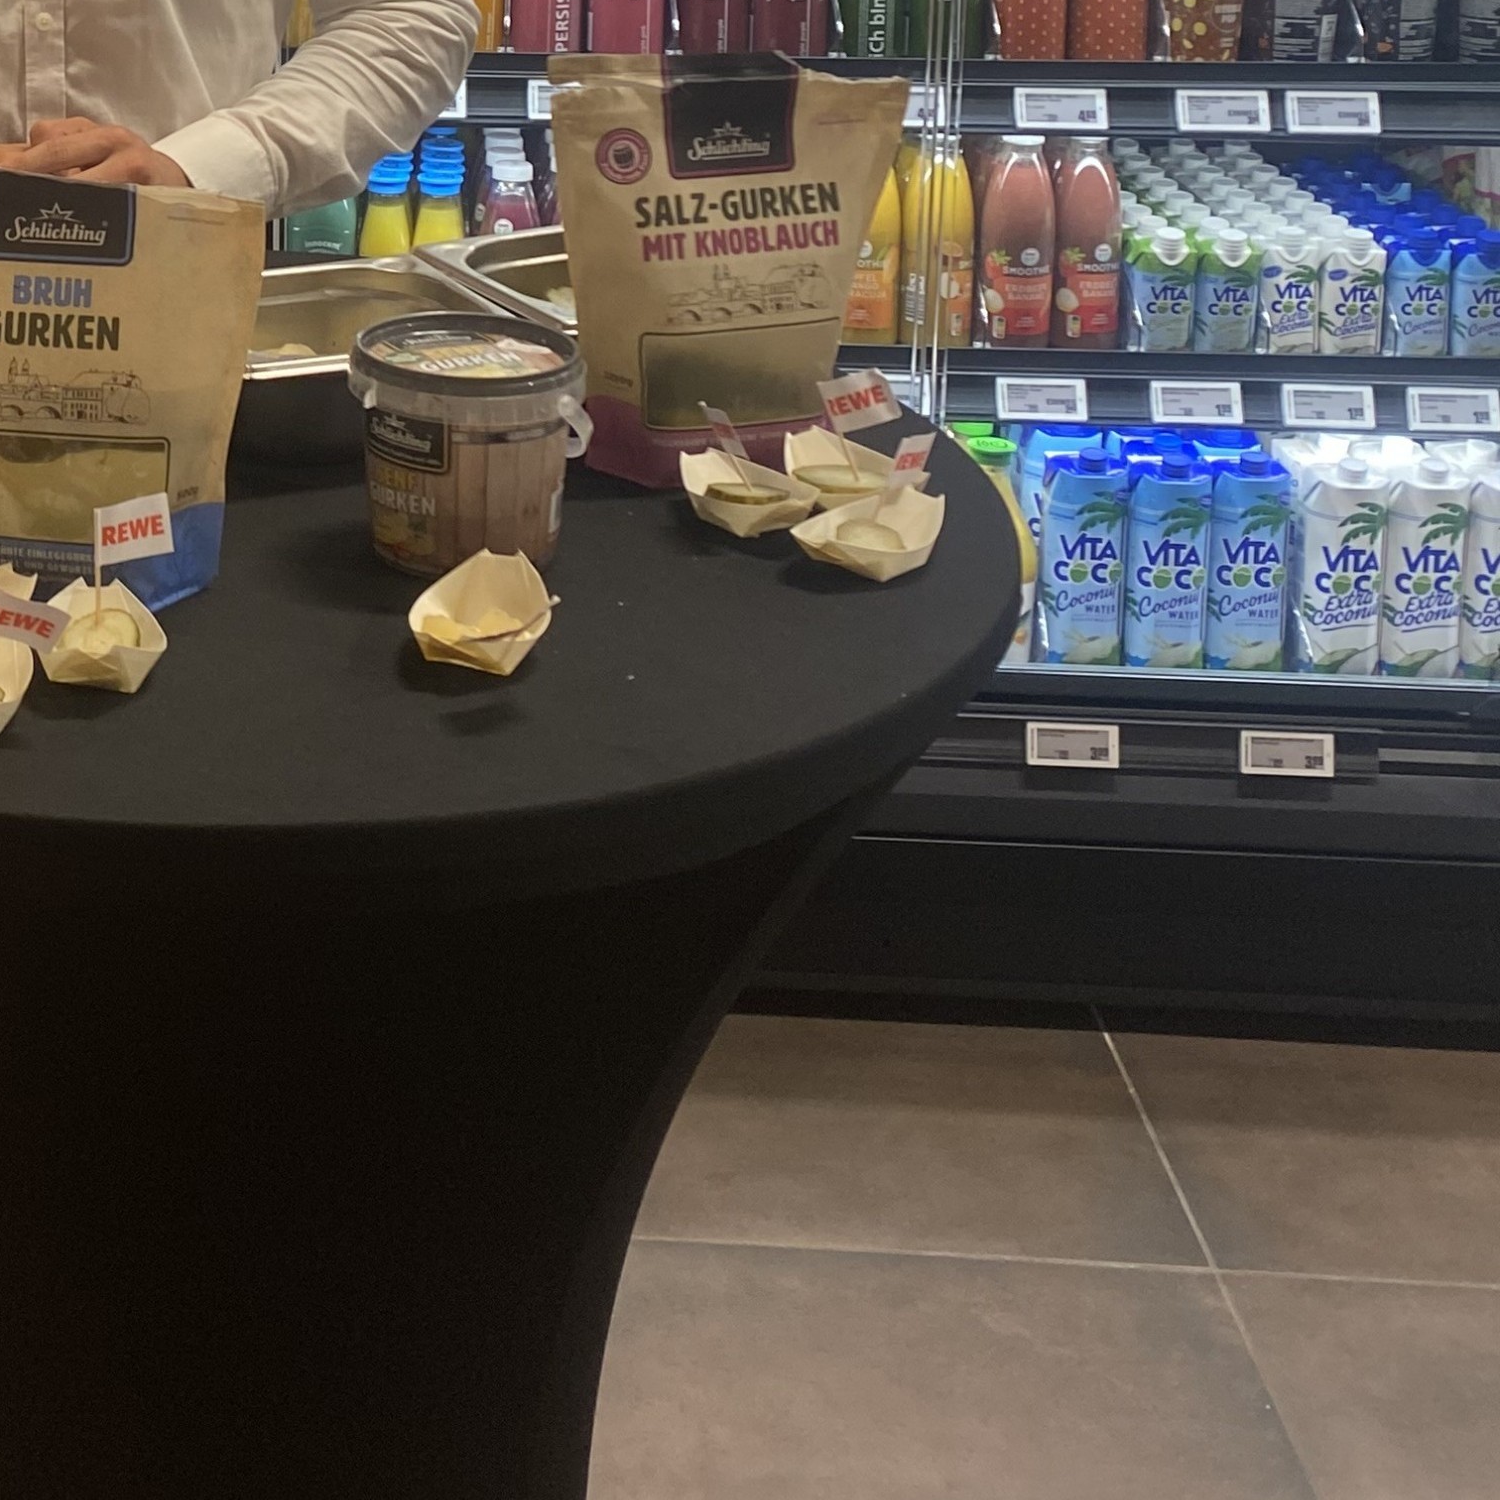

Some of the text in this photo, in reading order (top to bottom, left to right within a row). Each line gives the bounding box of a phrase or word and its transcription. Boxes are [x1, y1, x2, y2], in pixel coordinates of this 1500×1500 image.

[686, 133, 771, 162] Schlichting
[634, 181, 841, 229] SALZ-GURKEN
[4, 215, 107, 247] Schlichting
[642, 219, 840, 263] MIT KNOBLAUCH
[12, 274, 93, 308] BRÜH
[1151, 285, 1189, 301] VITA
[1213, 286, 1250, 302] VITA
[1275, 281, 1313, 299] VITA
[1340, 284, 1378, 302] VITA
[1405, 283, 1444, 301] VITA
[419, 351, 524, 373] GURKEN
[101, 514, 164, 547] REWE
[1060, 532, 1118, 560] VITA
[1142, 539, 1201, 567] VITA
[1222, 536, 1281, 565] VITA
[1321, 545, 1380, 573] VITA
[1401, 545, 1461, 573] VITA
